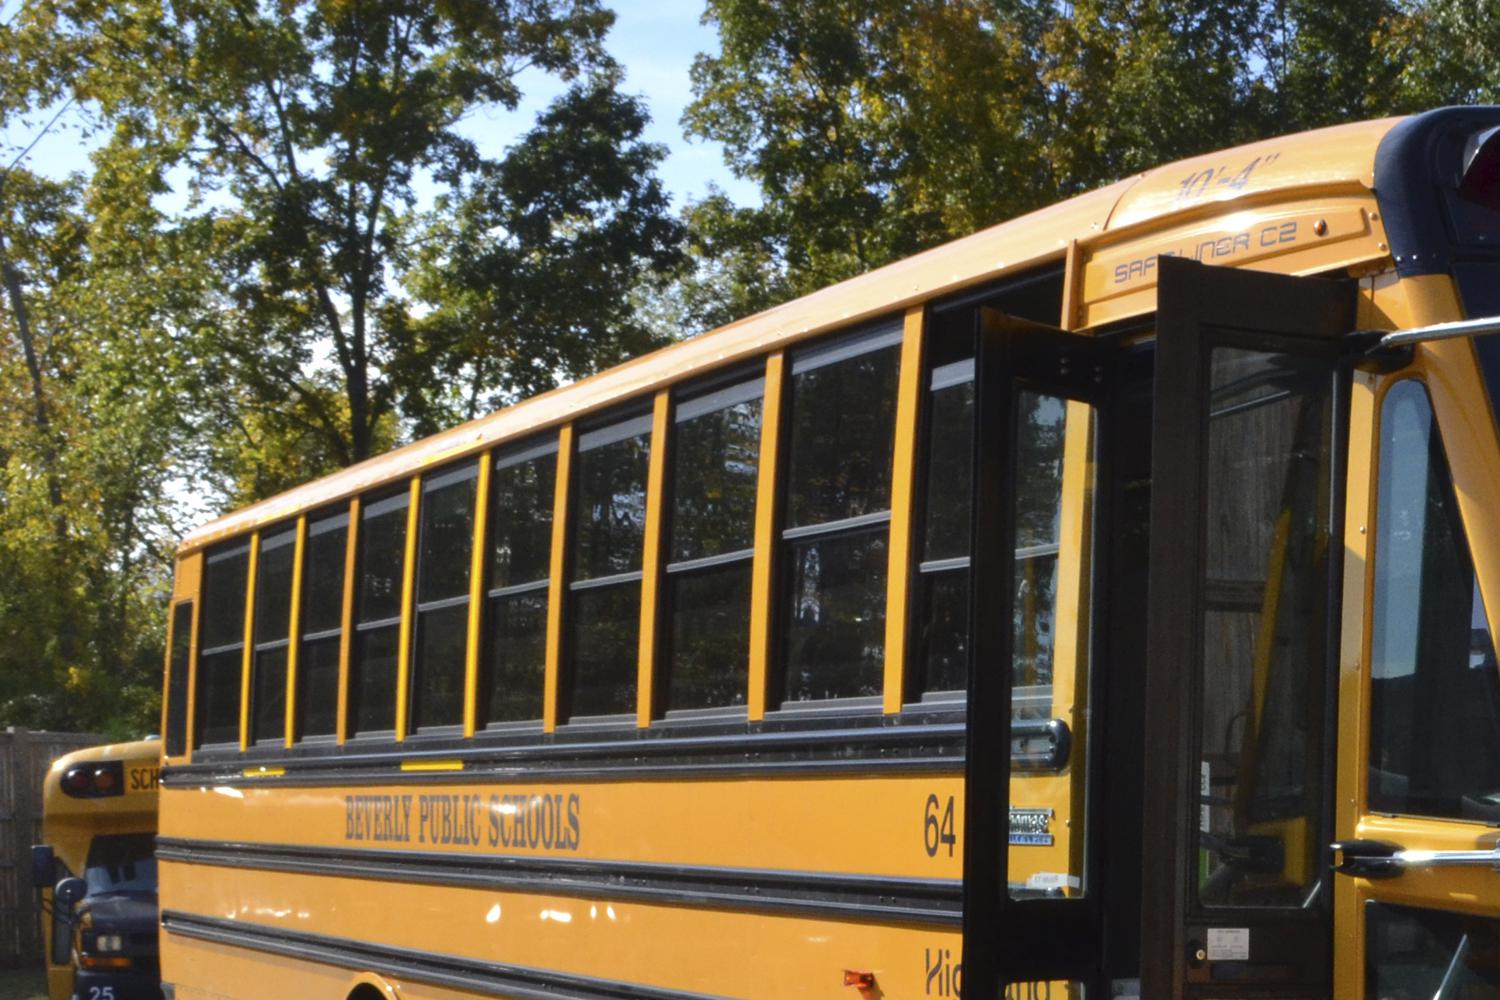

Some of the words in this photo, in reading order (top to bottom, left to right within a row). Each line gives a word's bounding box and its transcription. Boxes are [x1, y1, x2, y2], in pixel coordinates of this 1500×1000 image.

[1260, 221, 1297, 247] C2
[345, 794, 413, 842] BEVERLY
[418, 794, 481, 847] PUBLIC
[488, 793, 581, 851] SCHOOLS
[924, 793, 956, 858] 64
